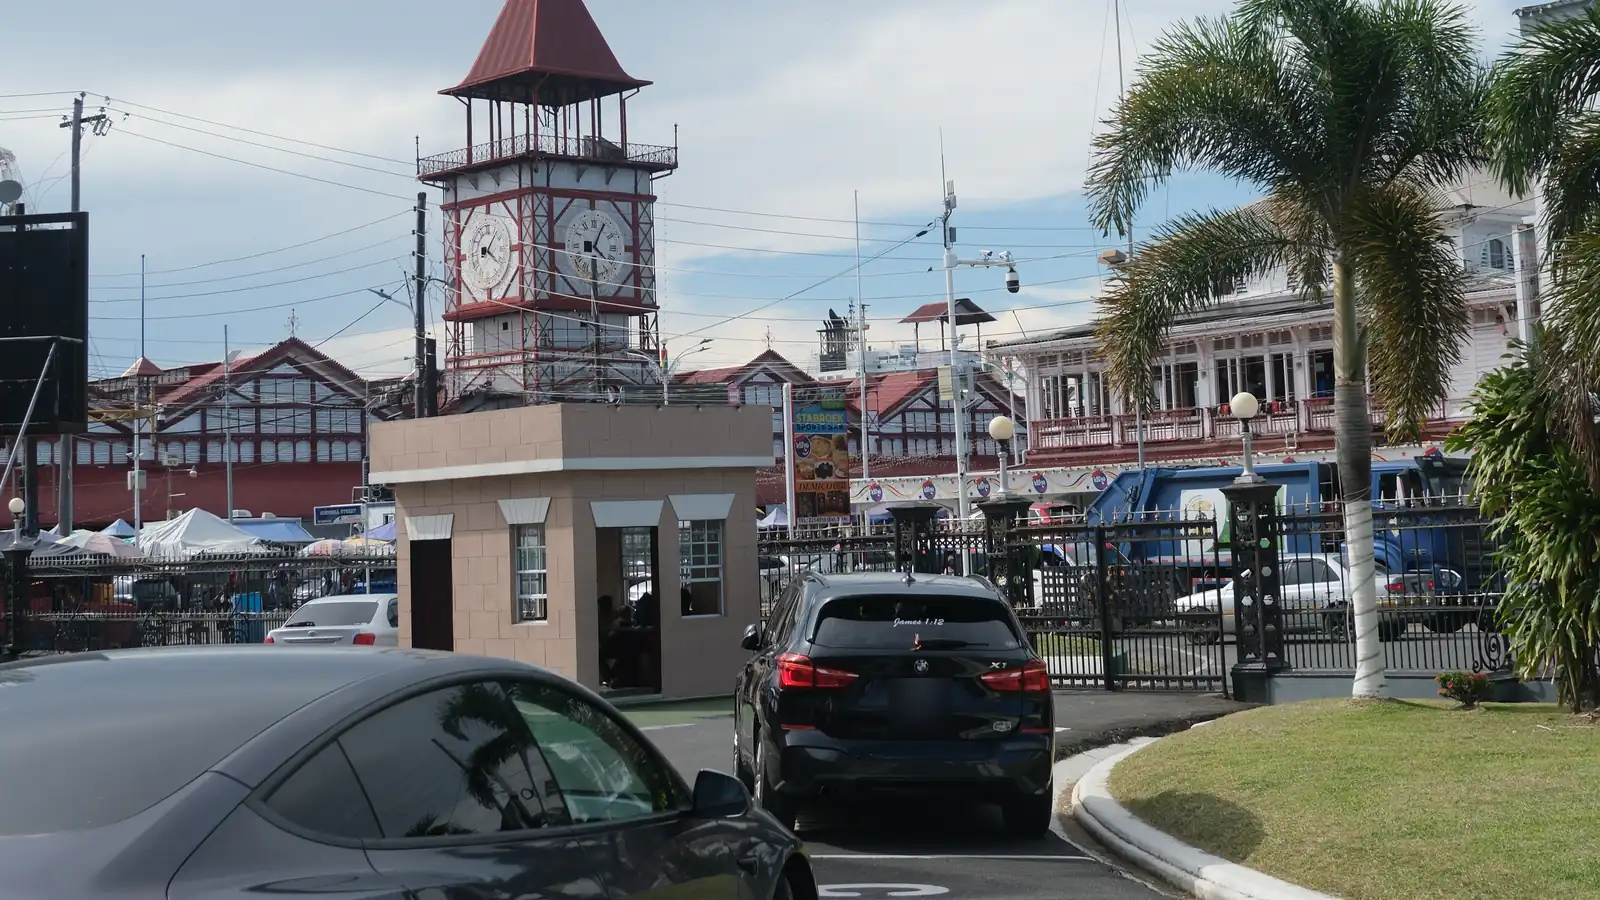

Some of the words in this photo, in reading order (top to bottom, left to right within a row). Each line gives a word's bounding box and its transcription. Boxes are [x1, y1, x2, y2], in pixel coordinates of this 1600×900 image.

[796, 413, 844, 423] STABROEK
[893, 618, 921, 627] James
[989, 661, 1008, 669] X1
